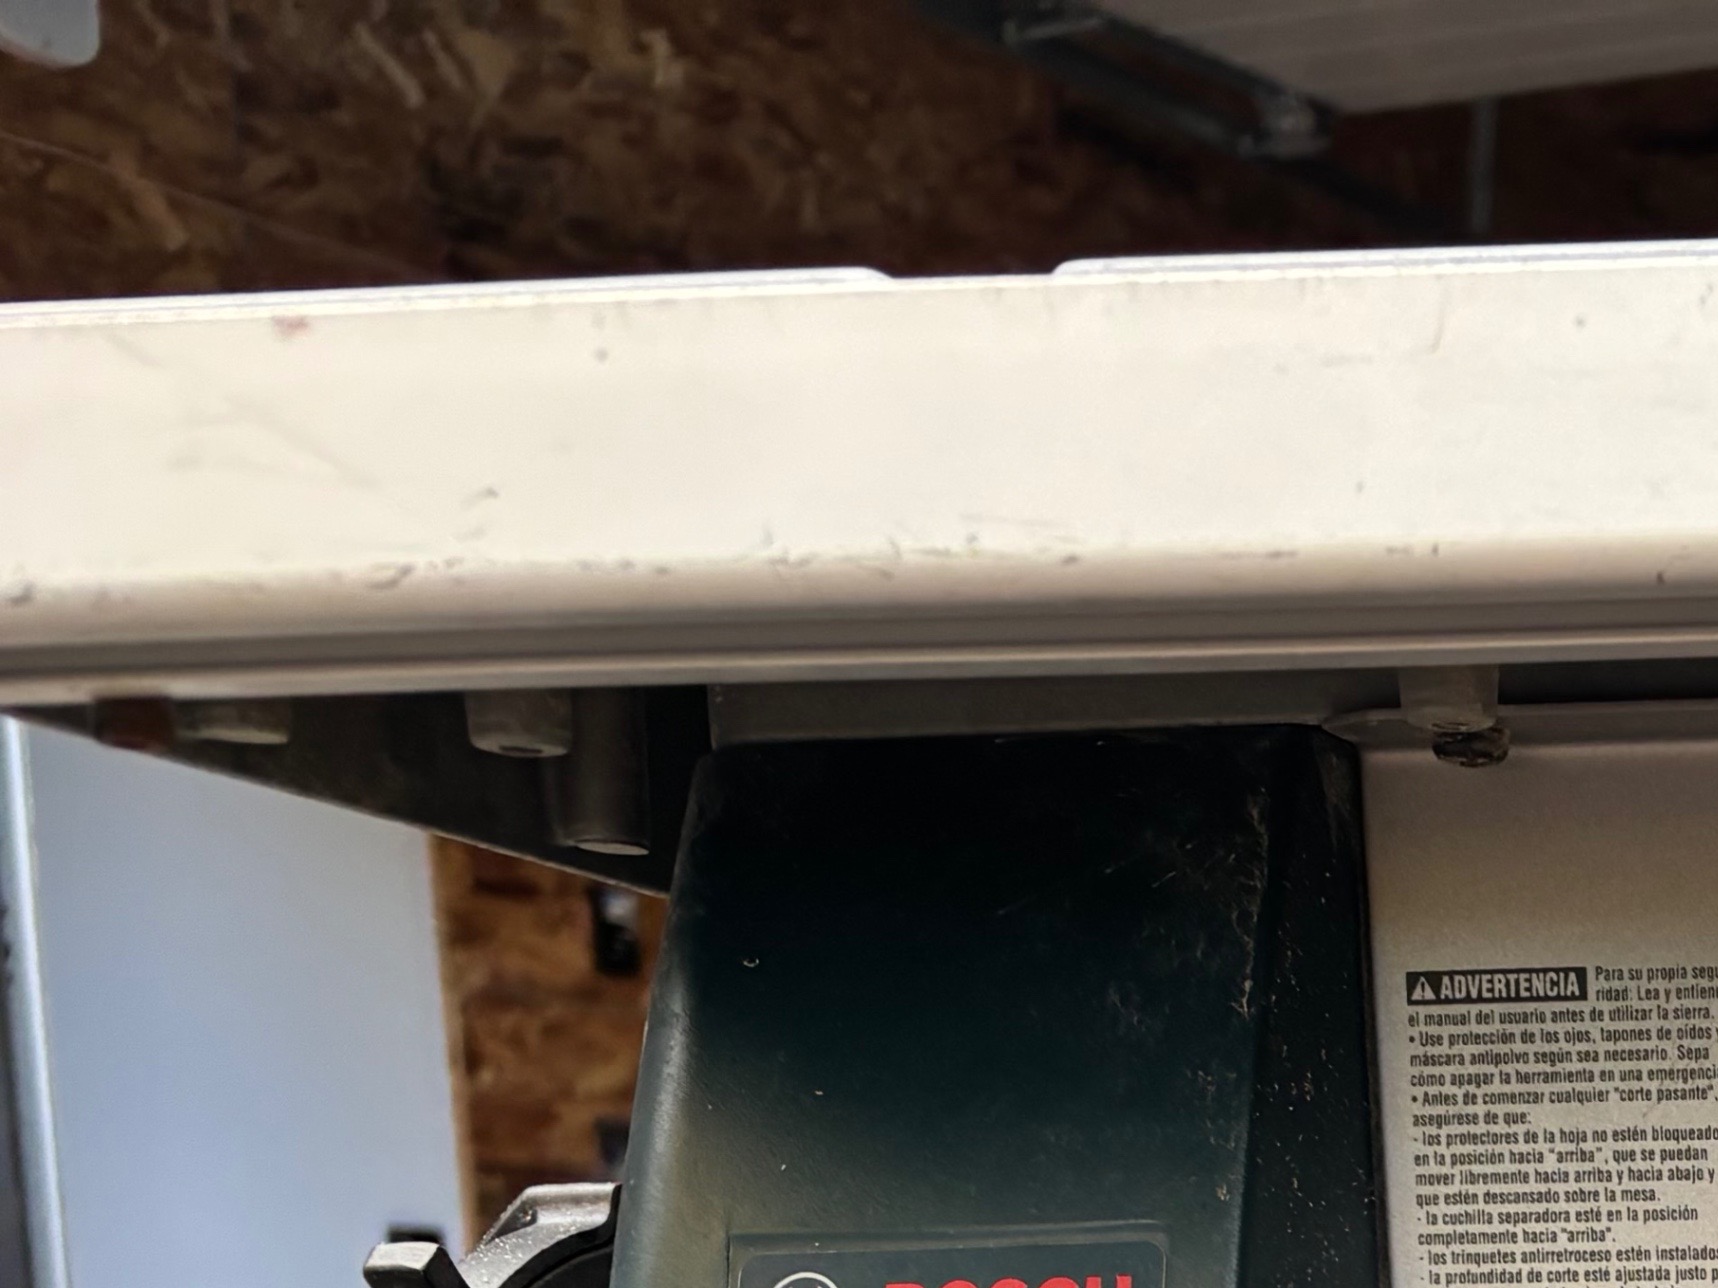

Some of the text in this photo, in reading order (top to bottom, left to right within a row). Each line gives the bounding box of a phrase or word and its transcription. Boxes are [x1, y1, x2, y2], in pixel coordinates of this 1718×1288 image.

[1440, 971, 1580, 1000] ADVERTENCIA
[1595, 966, 1624, 981] Para
[1628, 967, 1643, 980] su
[1647, 963, 1688, 984] propia
